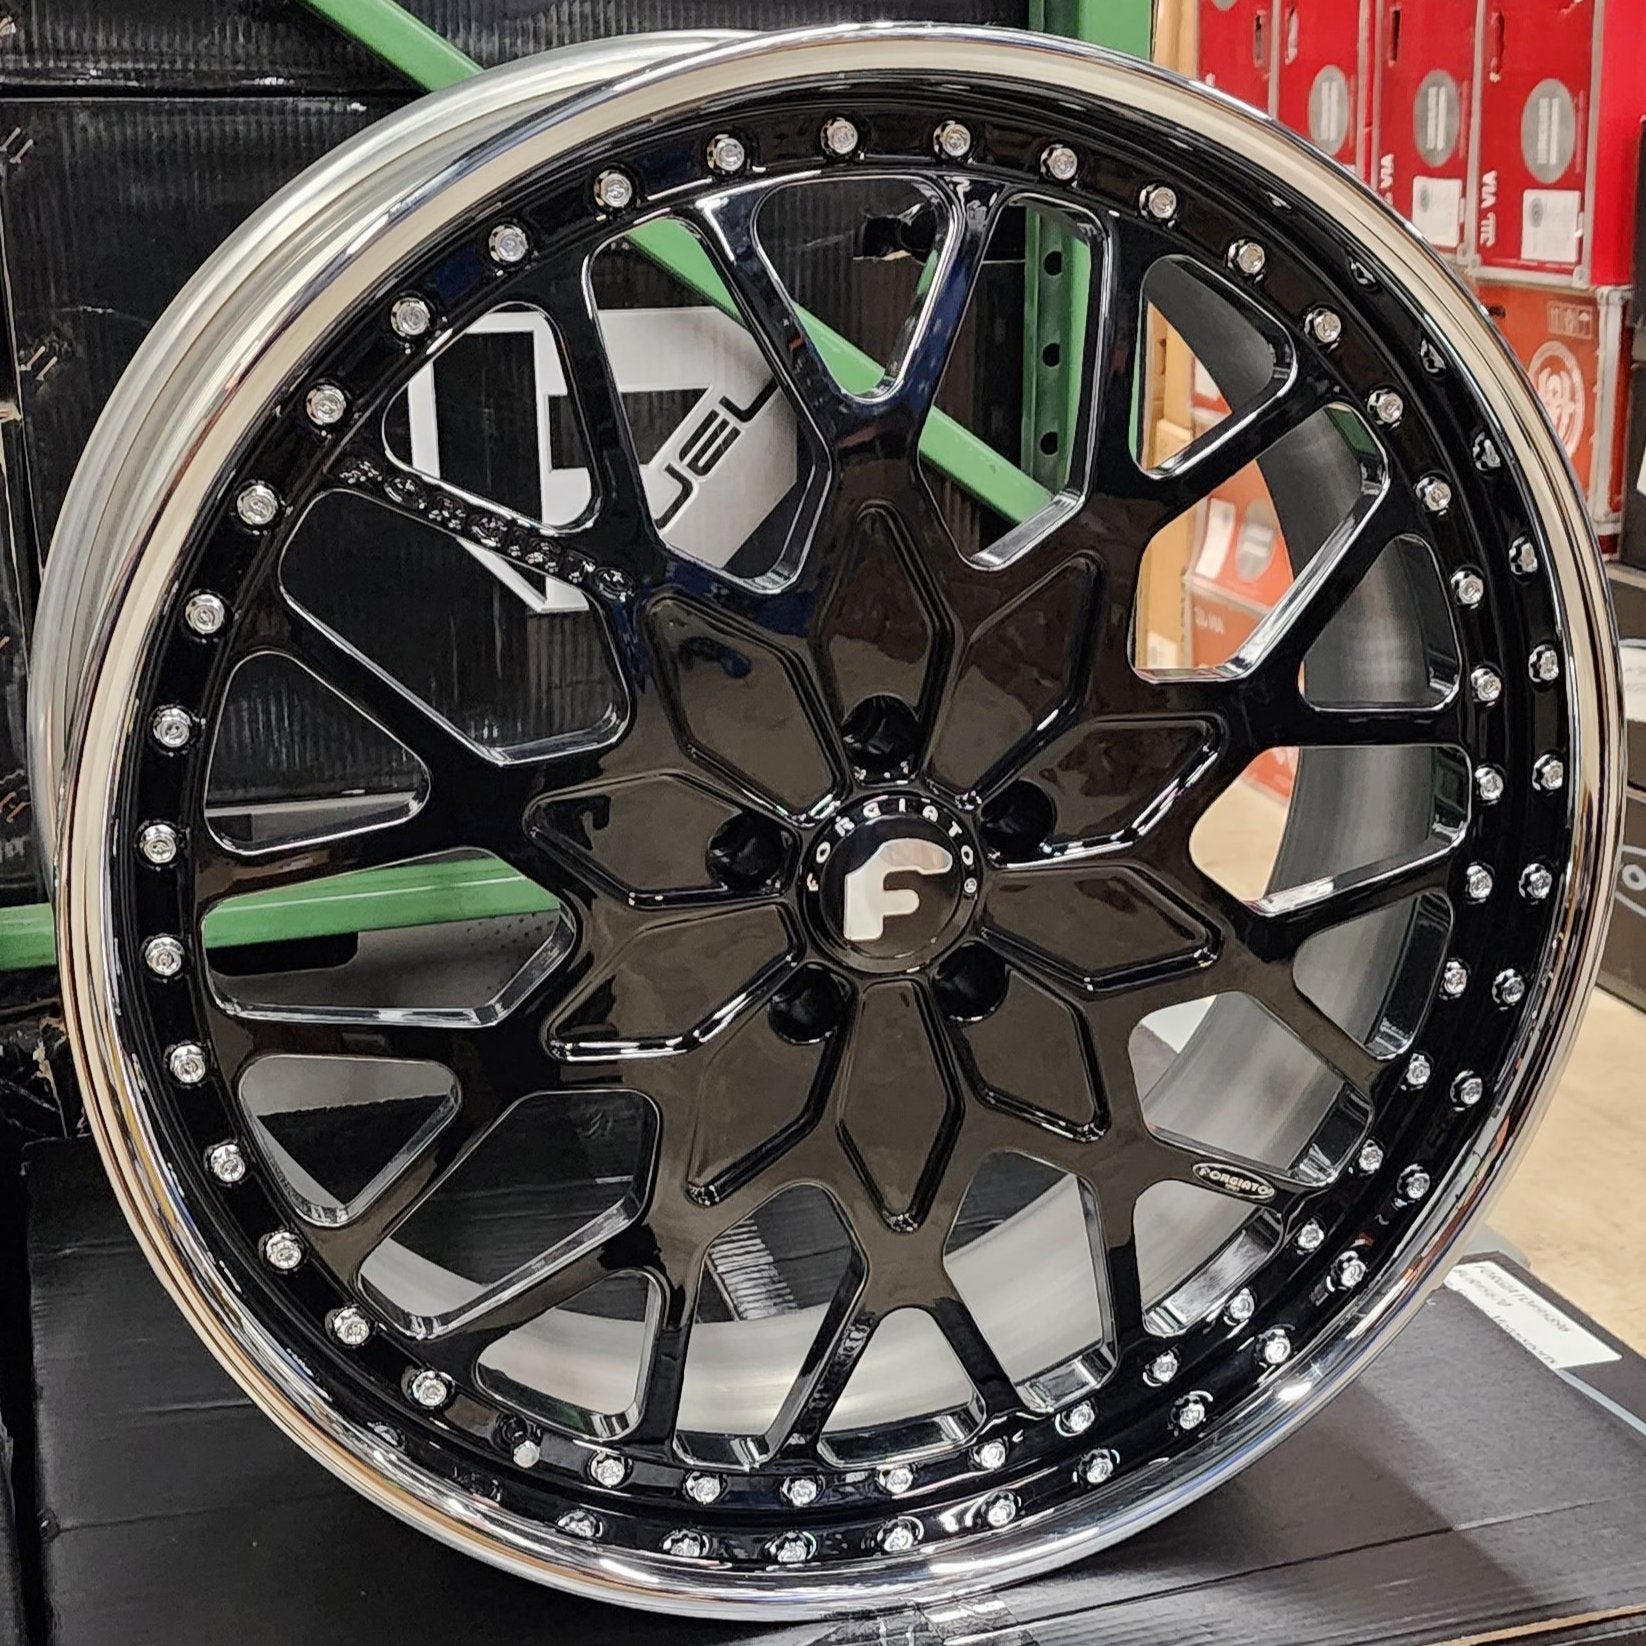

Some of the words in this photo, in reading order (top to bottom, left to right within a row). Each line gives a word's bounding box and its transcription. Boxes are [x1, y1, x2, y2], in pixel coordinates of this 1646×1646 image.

[654, 375, 779, 530] UEL
[806, 798, 973, 892] FORGIATO
[1198, 1167, 1269, 1195] FORGIATO
